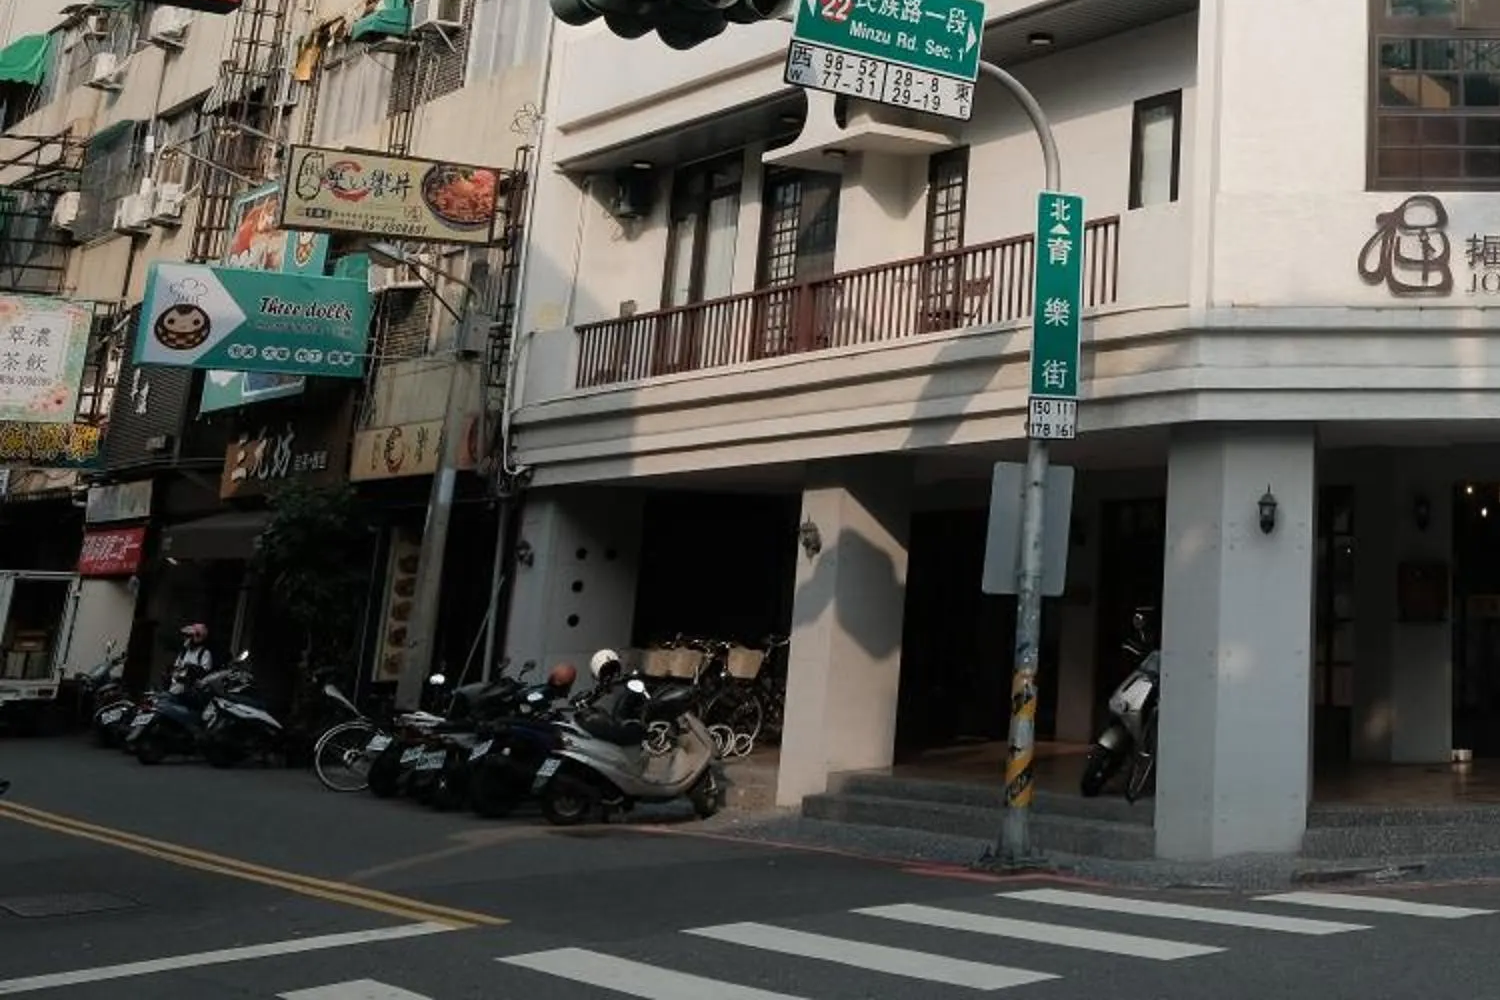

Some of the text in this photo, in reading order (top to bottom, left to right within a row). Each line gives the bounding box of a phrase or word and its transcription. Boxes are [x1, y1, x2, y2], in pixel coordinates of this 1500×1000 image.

[849, 19, 892, 45] Minzu
[895, 31, 917, 51] Rd.
[924, 38, 953, 60] Sec.
[791, 44, 813, 68] 西
[823, 52, 877, 79] 98-52
[954, 83, 973, 103] 東
[821, 71, 876, 97] 77-31
[892, 86, 941, 111] 29-19
[1050, 198, 1071, 221] 北
[260, 296, 353, 323] Three dolls
[1041, 237, 1072, 389] 育樂街
[1032, 401, 1051, 415] 150
[1031, 423, 1051, 437] 178
